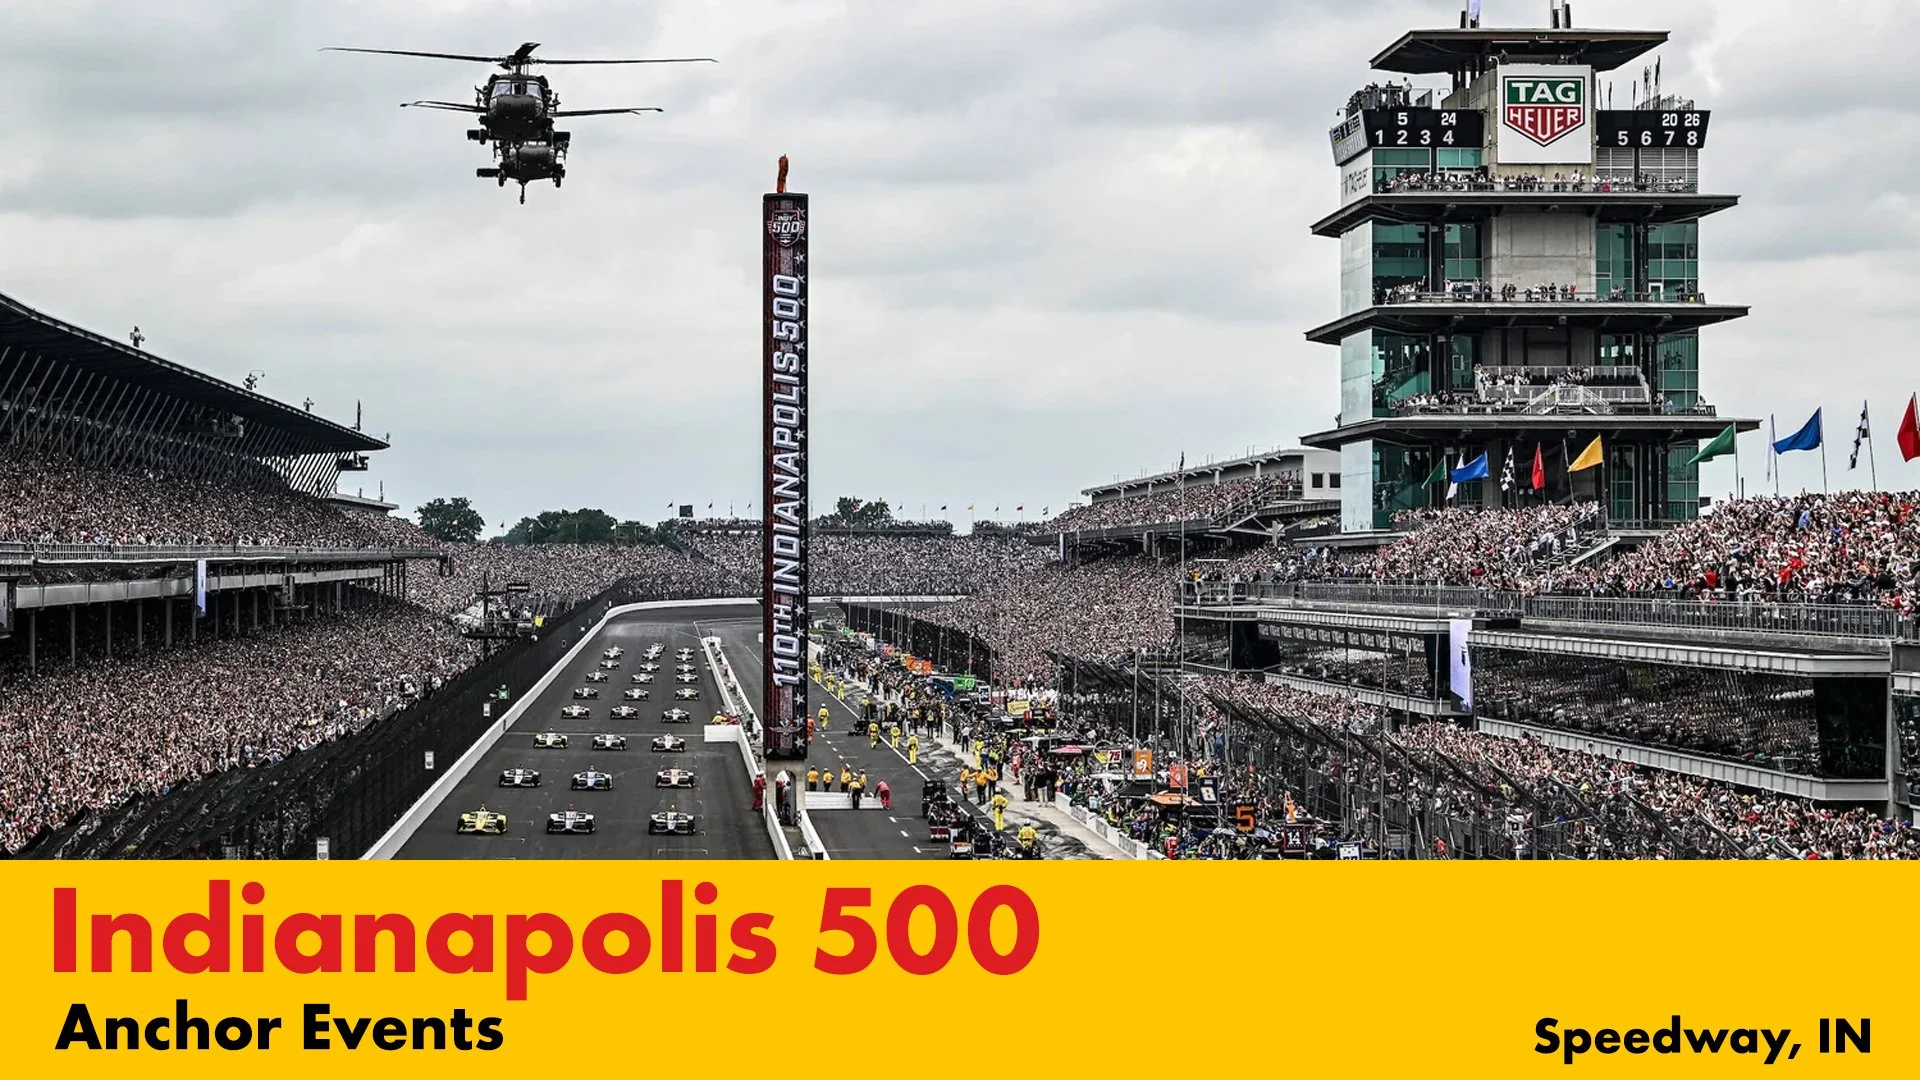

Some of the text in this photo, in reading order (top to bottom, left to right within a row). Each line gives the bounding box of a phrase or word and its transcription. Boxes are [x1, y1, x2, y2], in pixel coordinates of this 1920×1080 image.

[1511, 82, 1576, 103] TAG
[1397, 112, 1457, 126] 5 24
[1509, 108, 1579, 140] HEUER
[1662, 113, 1701, 127] 20 26
[1375, 129, 1383, 145] 1
[1396, 129, 1408, 145] 2
[1420, 129, 1431, 145] 3
[1442, 129, 1454, 145] 4
[1618, 130, 1698, 146] 5 6 7 8
[772, 221, 800, 234] 500
[772, 273, 801, 688] 110TH INDIANAPOLIS 500
[1235, 805, 1255, 832] 5
[1286, 831, 1301, 845] 14
